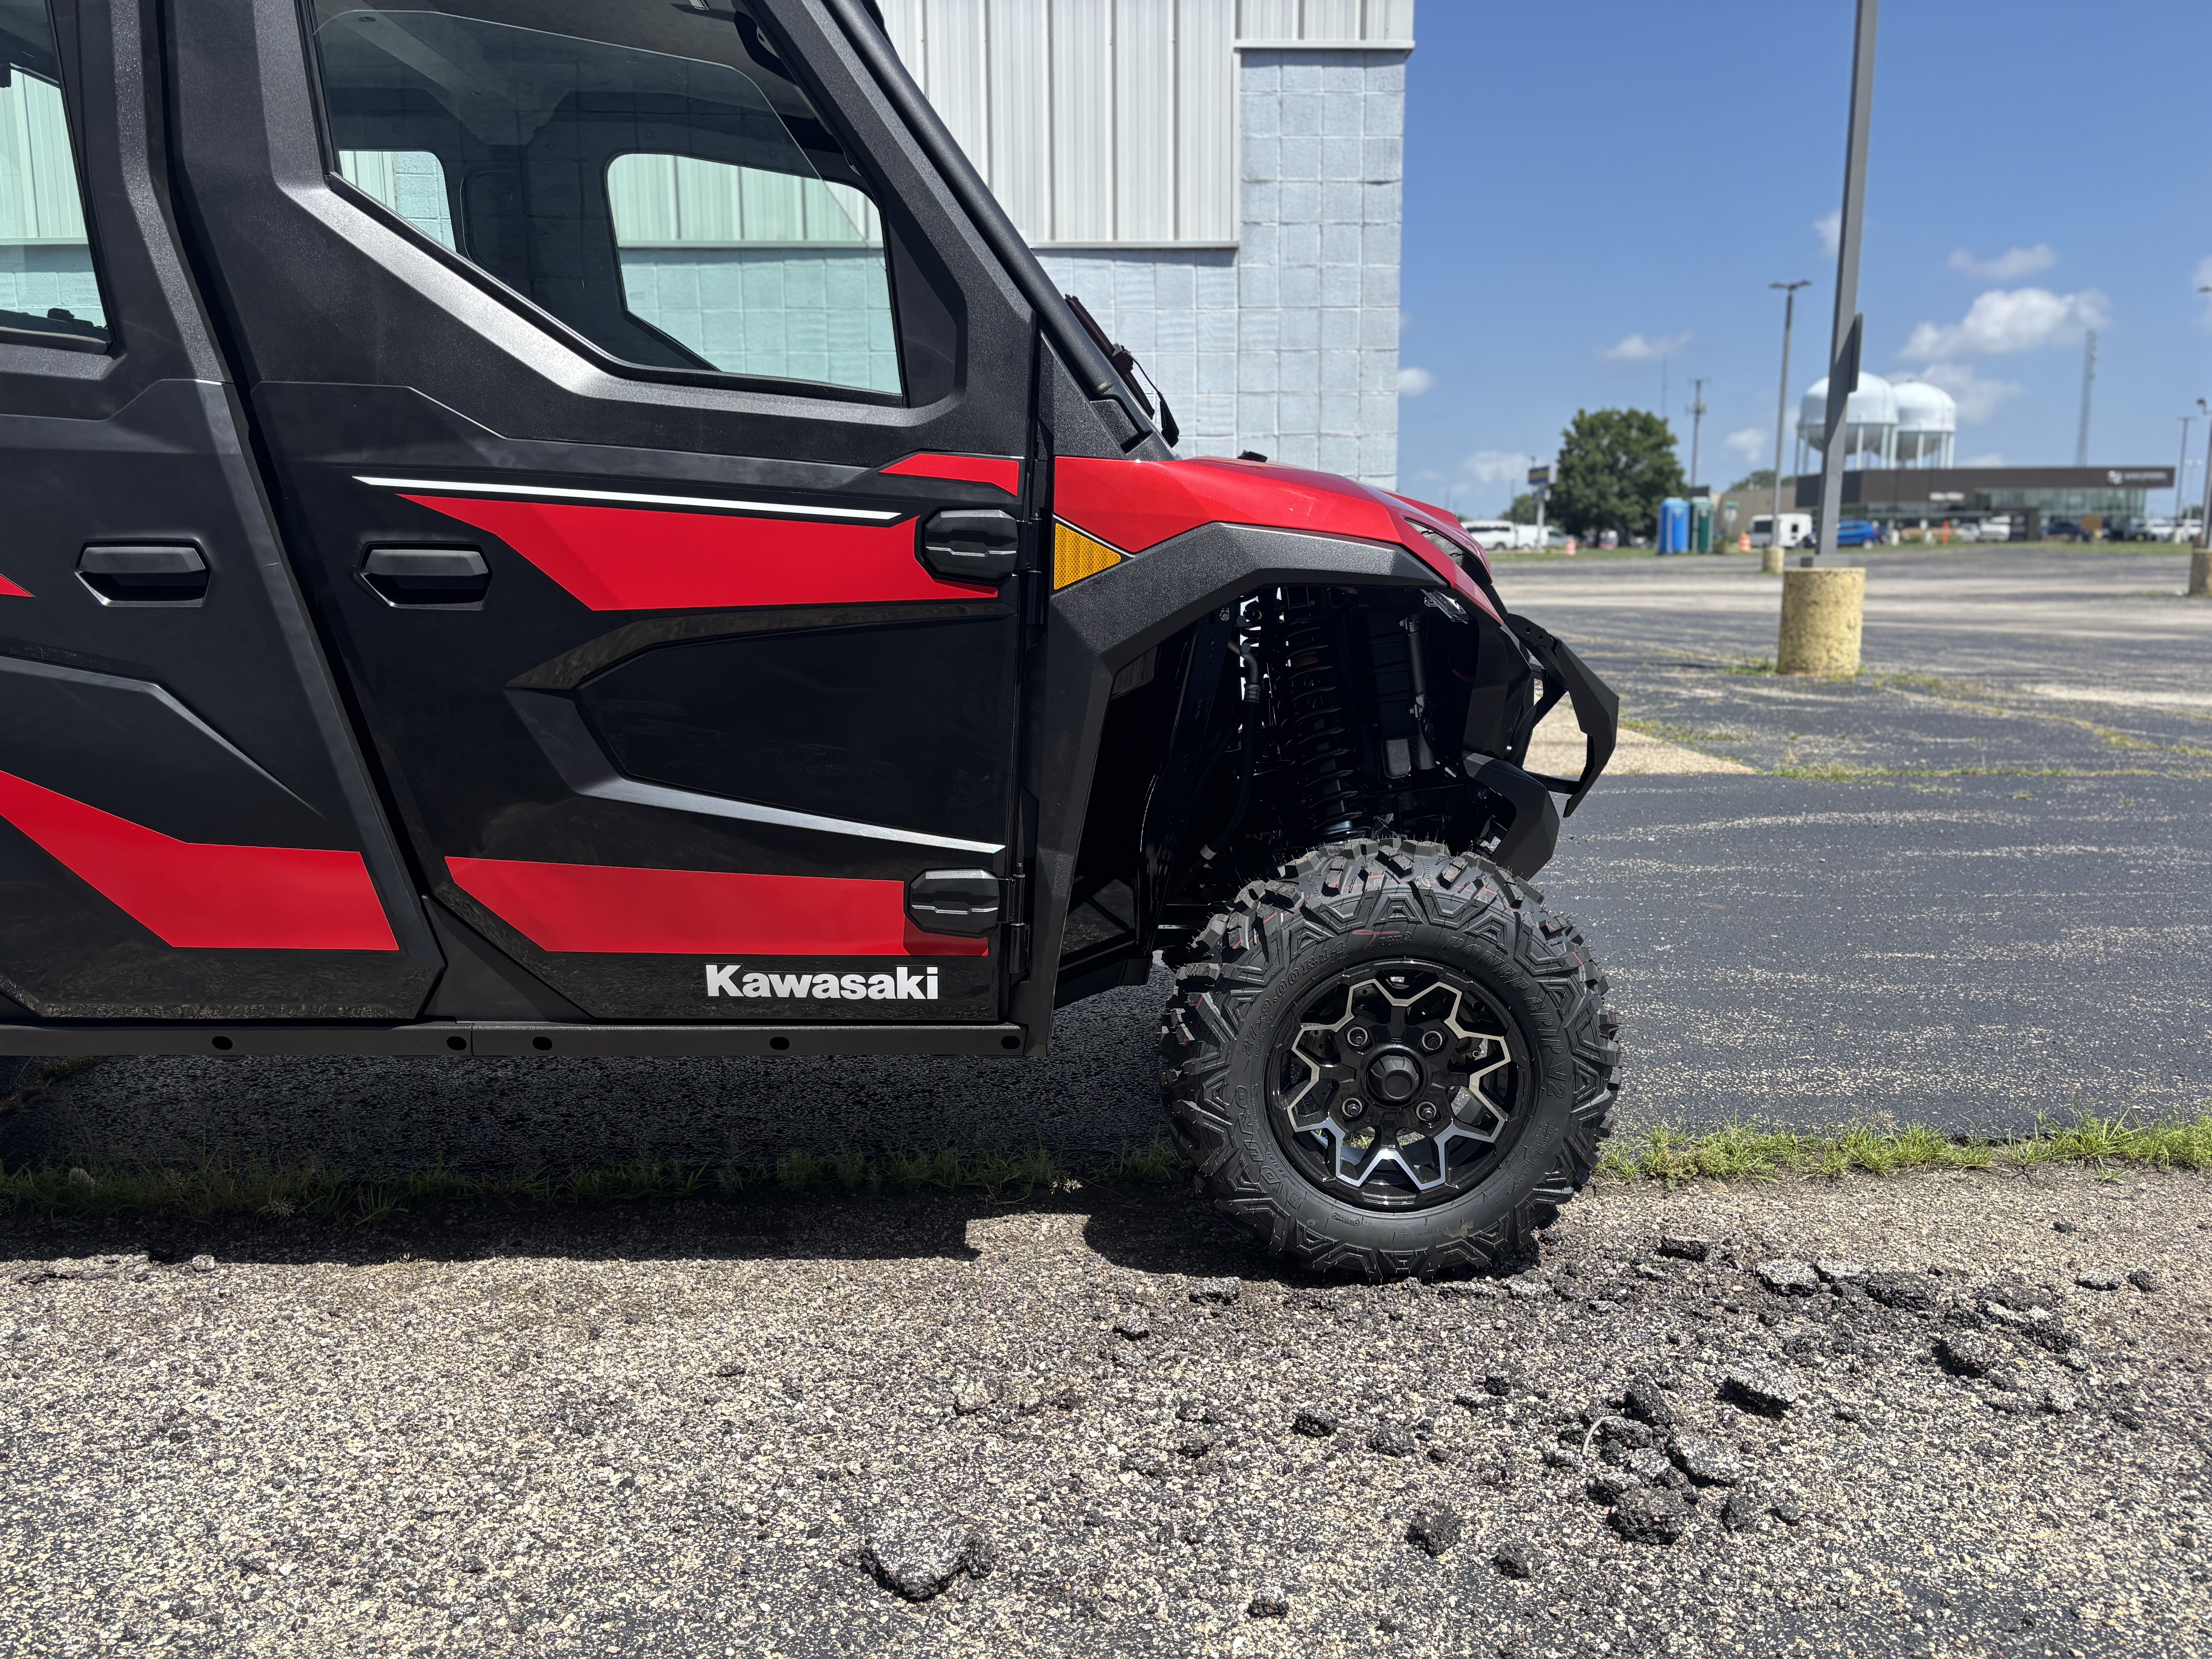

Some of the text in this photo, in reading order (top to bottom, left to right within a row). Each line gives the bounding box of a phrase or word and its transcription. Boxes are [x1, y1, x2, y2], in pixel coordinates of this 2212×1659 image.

[706, 965, 938, 1000] Kawasaki
[1441, 936, 1567, 1098] POWER GRIP V2
[1235, 1085, 1283, 1185] DURO
